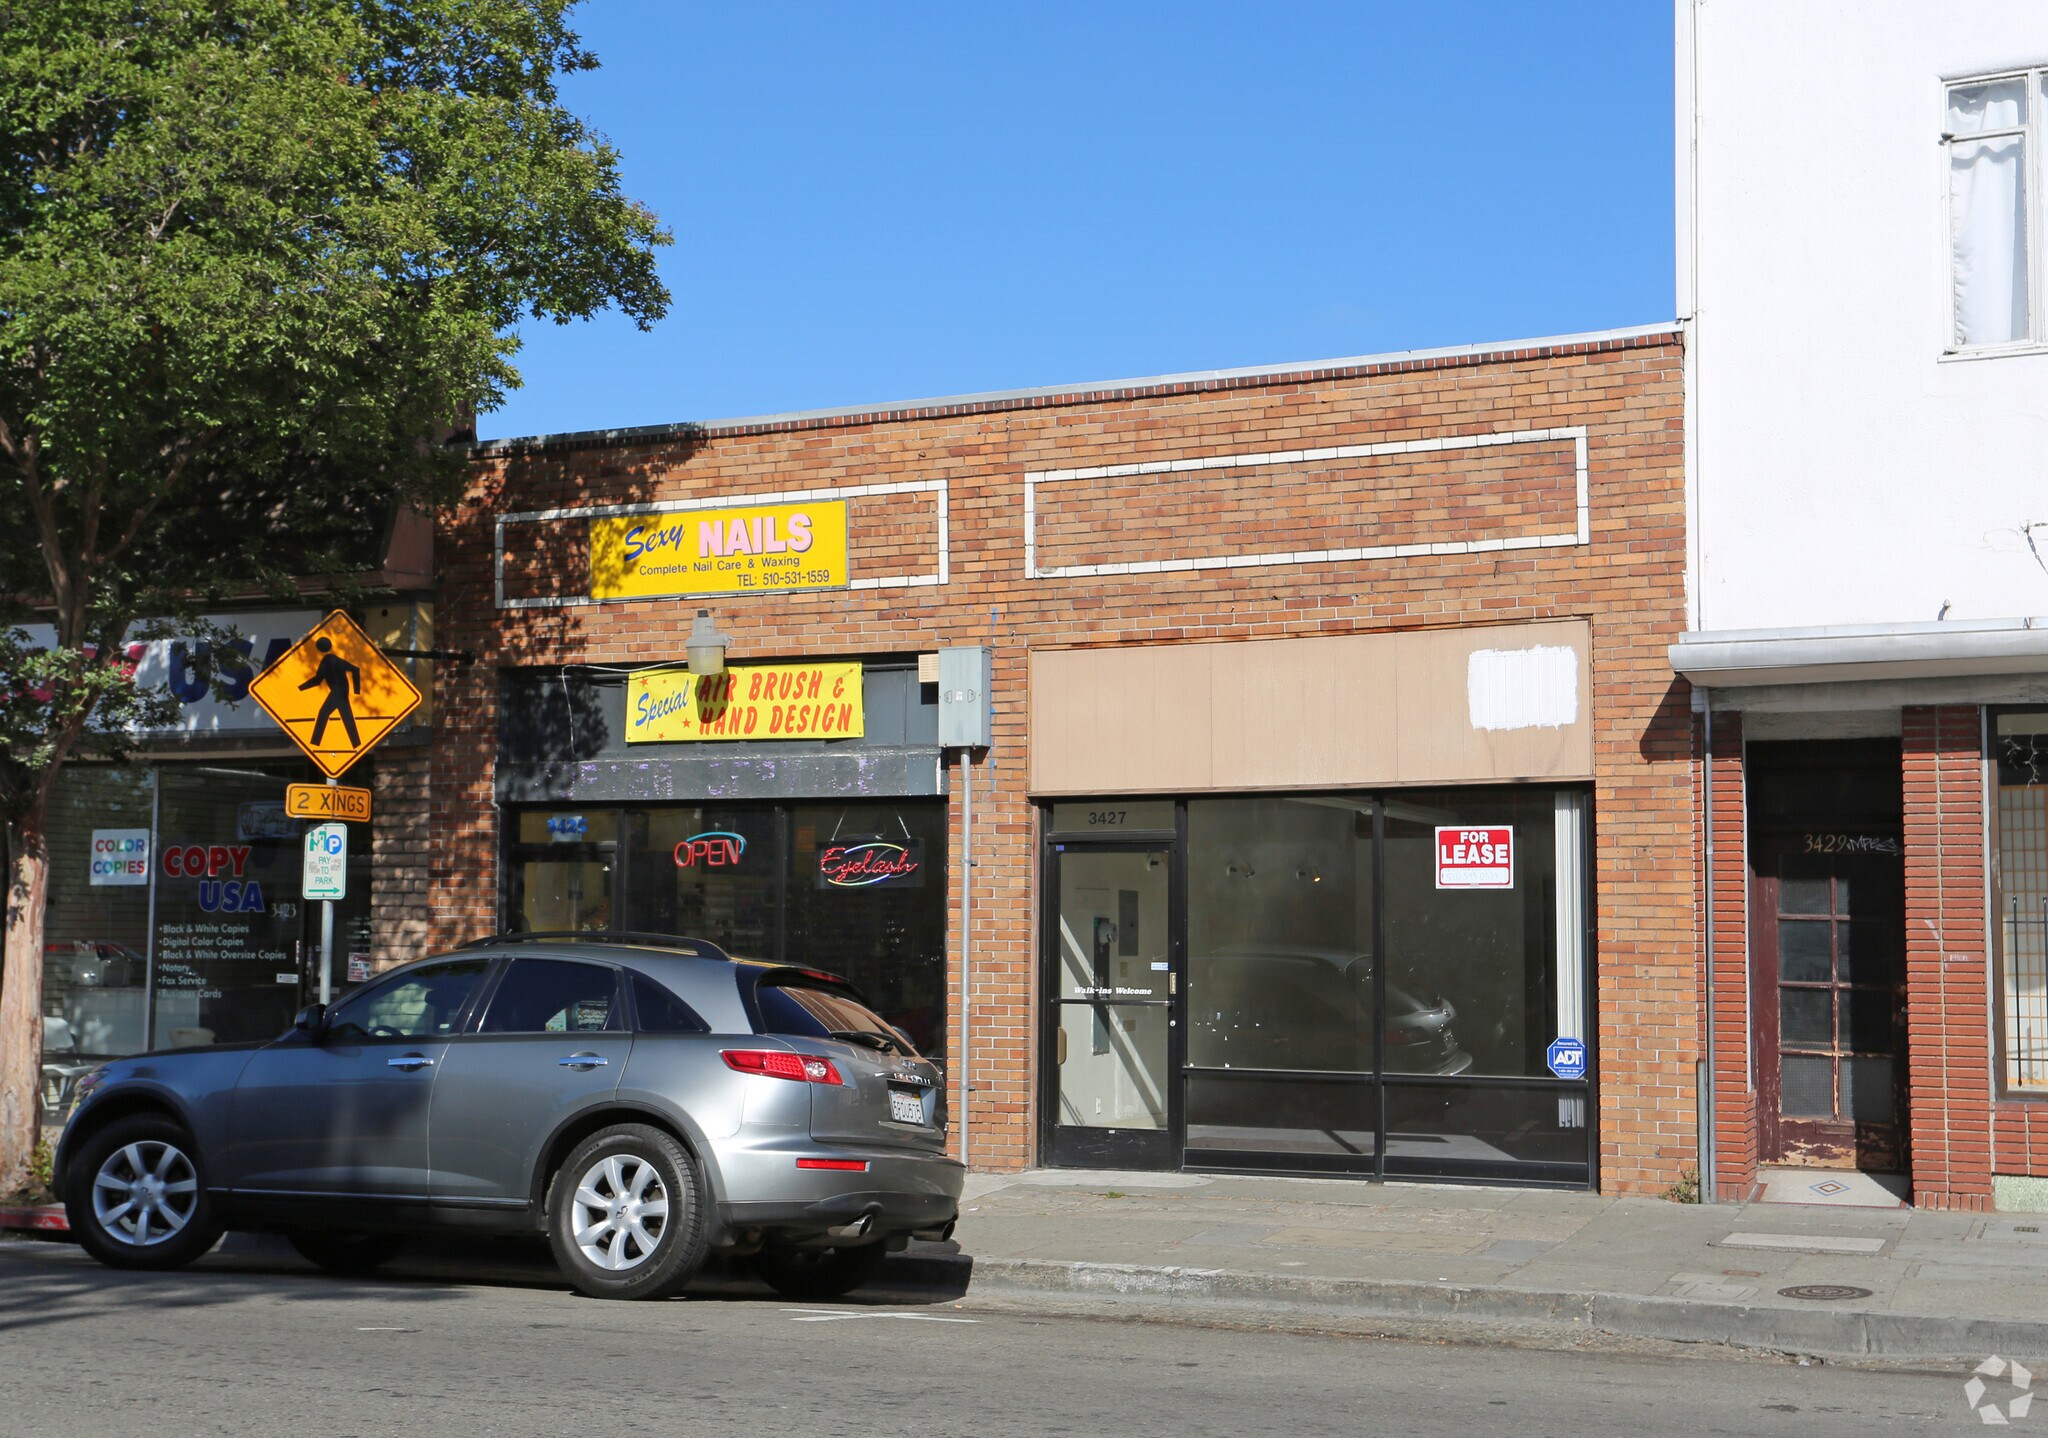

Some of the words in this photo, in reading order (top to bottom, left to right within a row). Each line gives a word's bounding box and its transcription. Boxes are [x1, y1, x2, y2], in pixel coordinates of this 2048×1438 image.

[624, 524, 685, 561] Sexy
[699, 513, 813, 558] NAILS
[639, 564, 688, 577] Complete
[693, 561, 713, 572] Nail
[717, 559, 742, 571] Care
[747, 558, 755, 569] &
[761, 556, 800, 570] Waxing
[737, 573, 758, 587] TEL:
[763, 569, 830, 586] 510-531-1559
[699, 673, 738, 702] AIR
[749, 670, 823, 701] BRUSH
[832, 677, 845, 699] &
[635, 678, 690, 731] Special
[699, 705, 758, 735] HAND
[769, 703, 853, 734] DESIGN
[297, 792, 311, 809] 2
[320, 793, 365, 813] XINGS
[1088, 811, 1127, 825] 3427
[546, 818, 588, 834] 3425
[1460, 831, 1489, 843] FOR
[1804, 834, 1847, 853] 3429
[95, 838, 145, 853] COLOR
[674, 838, 741, 868] OPEN
[163, 845, 252, 878] COPY
[318, 856, 332, 865] PAY
[1441, 843, 1509, 865] LEASE
[93, 860, 145, 874] COPIES
[320, 866, 330, 875] TO
[820, 846, 919, 884] Eyelash
[315, 876, 334, 885] PARK
[199, 880, 265, 913] USA
[163, 924, 185, 934] Black
[186, 925, 193, 934] &
[195, 924, 219, 934] White
[221, 924, 249, 935] Copies
[162, 937, 189, 948] Digital
[191, 937, 214, 946] Color
[216, 937, 244, 948] Copies
[162, 950, 184, 959] Black
[186, 950, 192, 959] &
[194, 950, 219, 959] White
[220, 949, 256, 959] Oversize
[258, 950, 287, 961] Copies
[162, 963, 190, 974] Notary
[162, 976, 176, 985] Fax
[178, 976, 207, 985] Service
[198, 988, 222, 999] Cards
[1073, 986, 1112, 995] Walk-ins
[1115, 986, 1152, 995] Welcome
[1555, 1050, 1582, 1065] ADT
